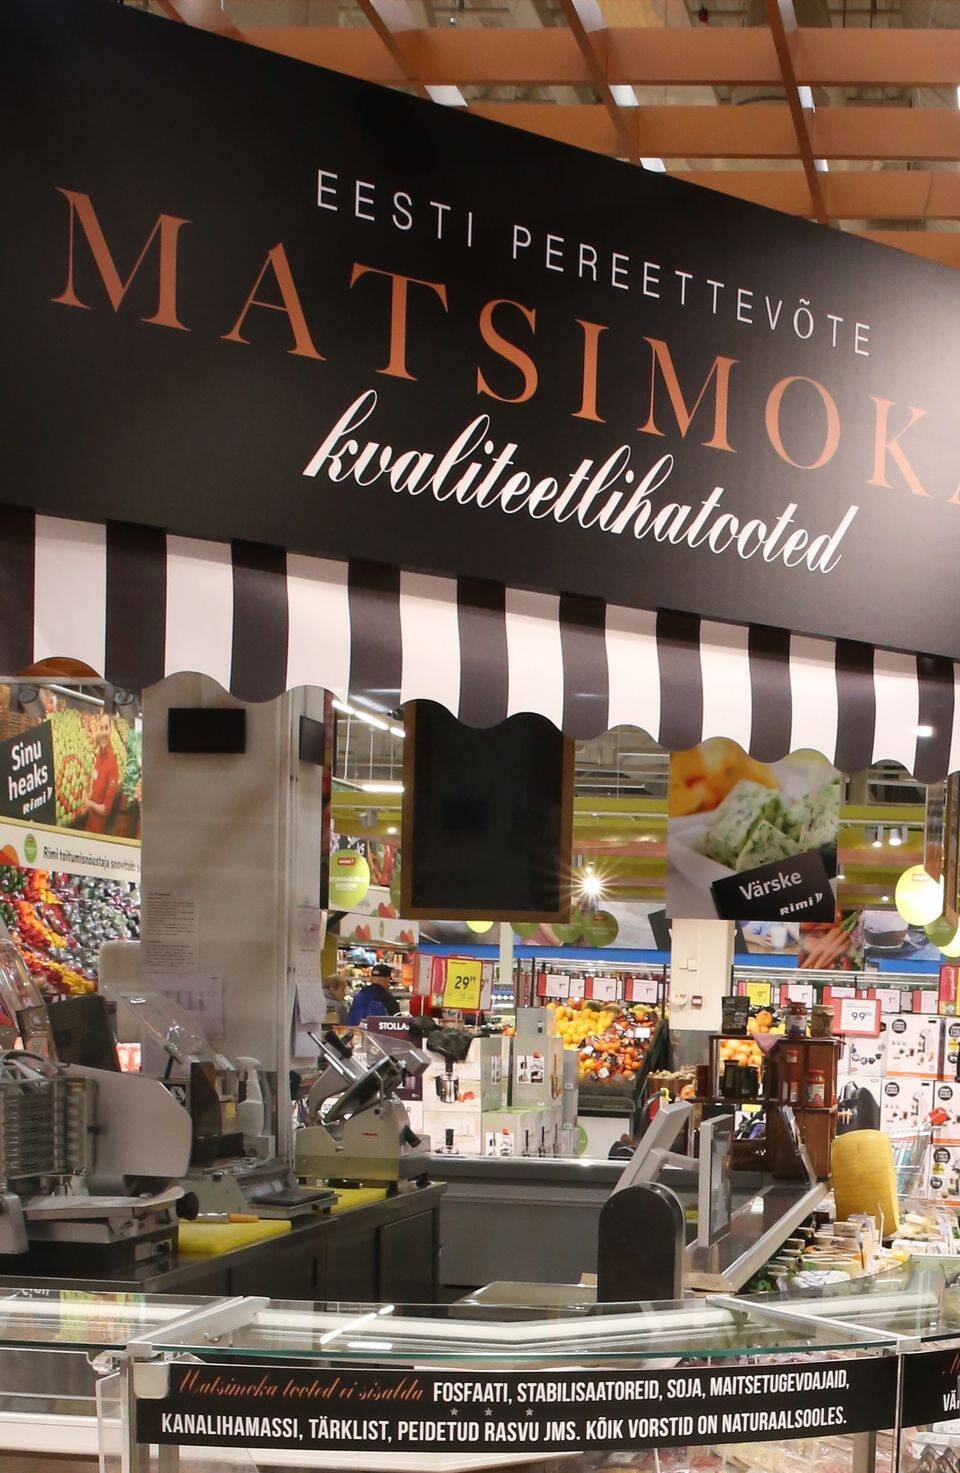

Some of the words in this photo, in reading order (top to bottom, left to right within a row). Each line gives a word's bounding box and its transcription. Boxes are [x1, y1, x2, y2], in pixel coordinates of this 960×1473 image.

[317, 169, 475, 247] EESTI
[512, 225, 871, 357] PEREETTEVÕTE
[302, 389, 859, 574] kvaliteetlihatooted
[12, 741, 42, 771] Sinu
[8, 764, 49, 801] heaks
[44, 846, 58, 860] Rimi
[739, 872, 802, 900] Värske
[179, 1368, 278, 1399] Matsimoka
[340, 1380, 358, 1400] ei
[433, 1381, 513, 1405] FOSFAATI,
[517, 1379, 664, 1403] STABILISAATOREID,
[667, 1377, 706, 1400] SOJA,
[710, 1368, 851, 1398] MAITSETUGEVDAJAID,
[161, 1412, 304, 1440] KANALIHAMASSI,
[308, 1416, 392, 1444] TÄRKLIST,
[398, 1421, 479, 1443] PEIDETUD
[484, 1421, 539, 1443] RASVU
[544, 1420, 581, 1442] JMS.
[586, 1416, 623, 1441] KÕIK
[628, 1415, 693, 1438] VORSTID
[698, 1414, 717, 1435] ON
[722, 1405, 847, 1435] NATURAALSOOLES.
